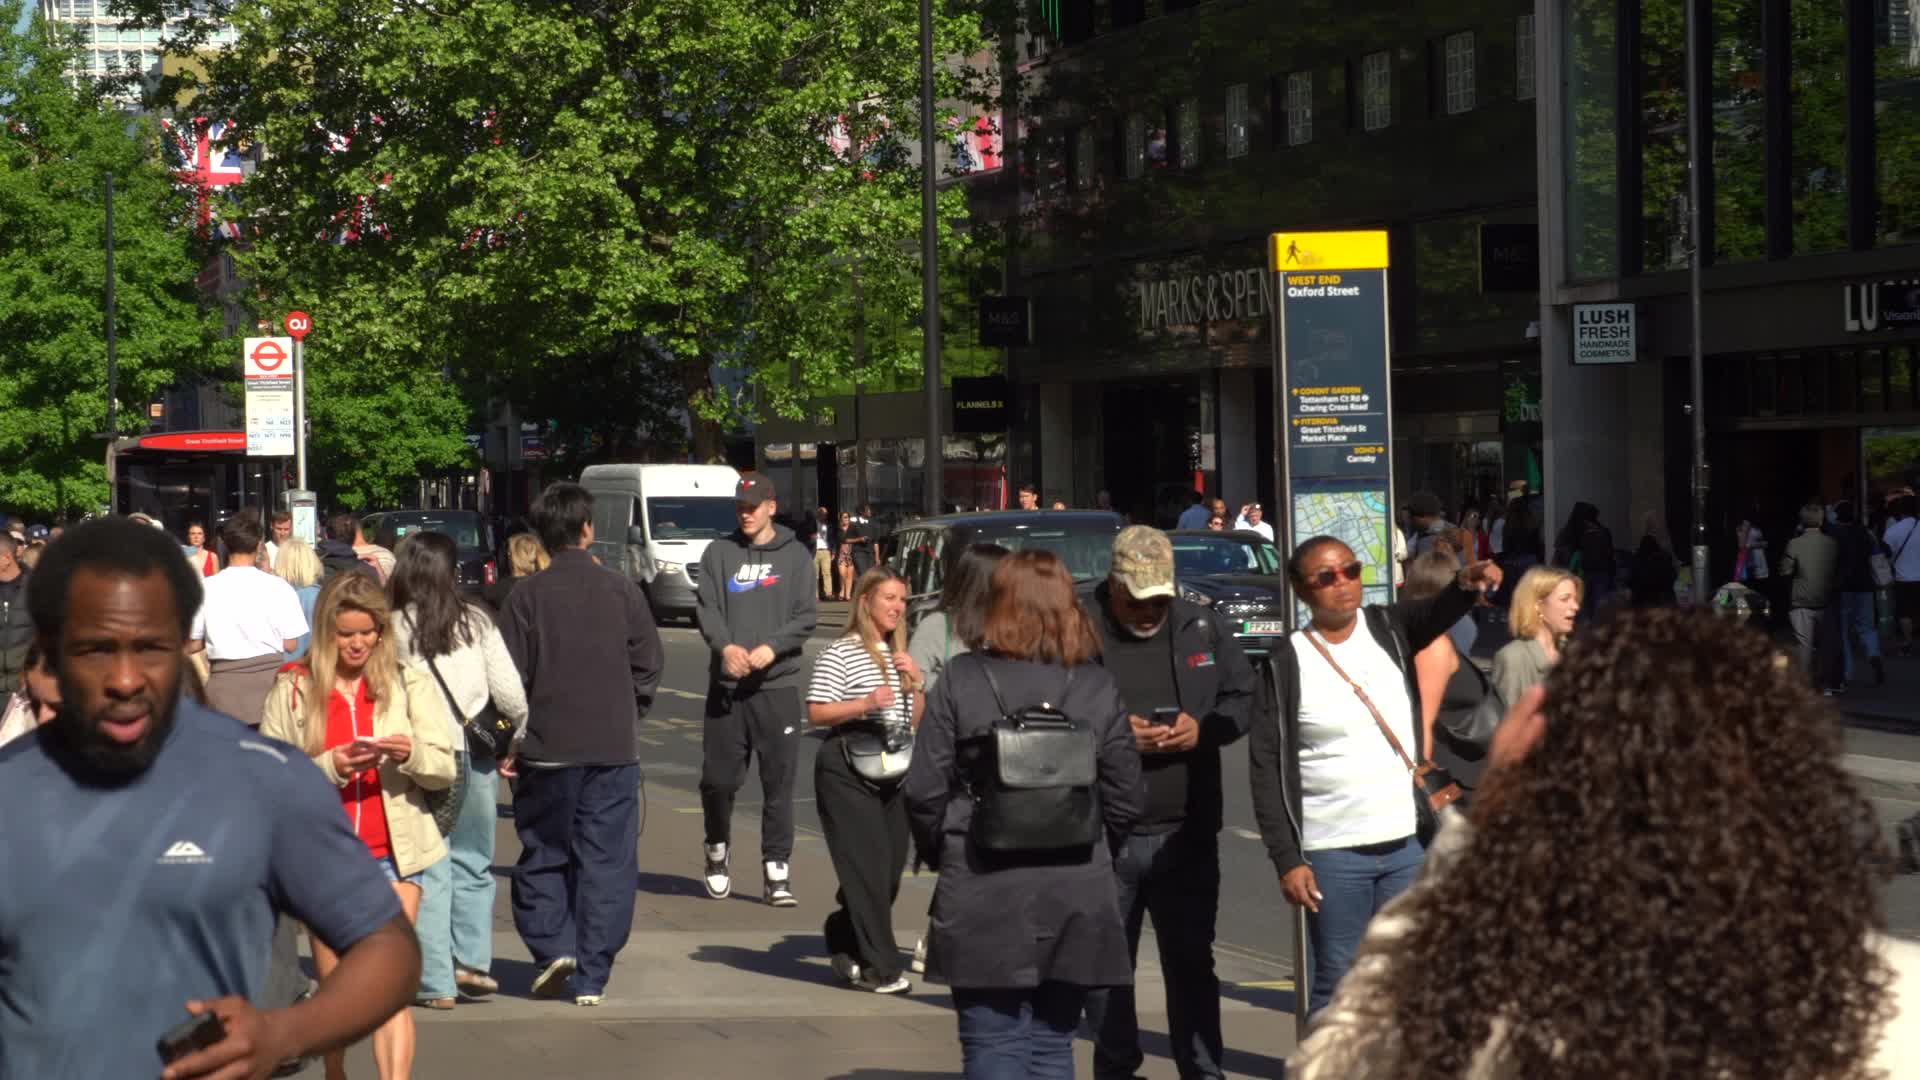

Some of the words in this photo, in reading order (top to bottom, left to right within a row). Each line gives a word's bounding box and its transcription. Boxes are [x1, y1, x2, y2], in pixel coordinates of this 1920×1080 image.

[1288, 276, 1316, 286] WEST
[1319, 275, 1341, 285] END
[1288, 287, 1324, 297] Oxford
[1327, 286, 1360, 297] Street
[1141, 276, 1202, 329] MARKS
[1207, 275, 1220, 321] &
[1579, 310, 1629, 324] LUSH
[289, 318, 307, 330] OJ
[1580, 326, 1630, 339] FRESH
[1580, 341, 1631, 349] HANDMADE
[1580, 350, 1631, 358] COSMETICS
[1300, 387, 1329, 395] COVENT
[1331, 386, 1361, 394] GARDEN
[1300, 395, 1339, 403] Tottenham
[1340, 395, 1349, 403] Ct
[1350, 394, 1361, 402] Rd
[1300, 403, 1328, 413] Charing
[1329, 403, 1349, 411] Cross
[1350, 402, 1368, 411] Road
[1301, 417, 1338, 425] FITZROVIA
[1301, 426, 1322, 434] Great
[1323, 425, 1357, 433] Titchfield
[1358, 424, 1367, 433] St
[1301, 434, 1327, 442] Market
[1327, 434, 1347, 442] Place
[1354, 447, 1377, 455] SOHO
[1347, 456, 1376, 464] Carnaby
